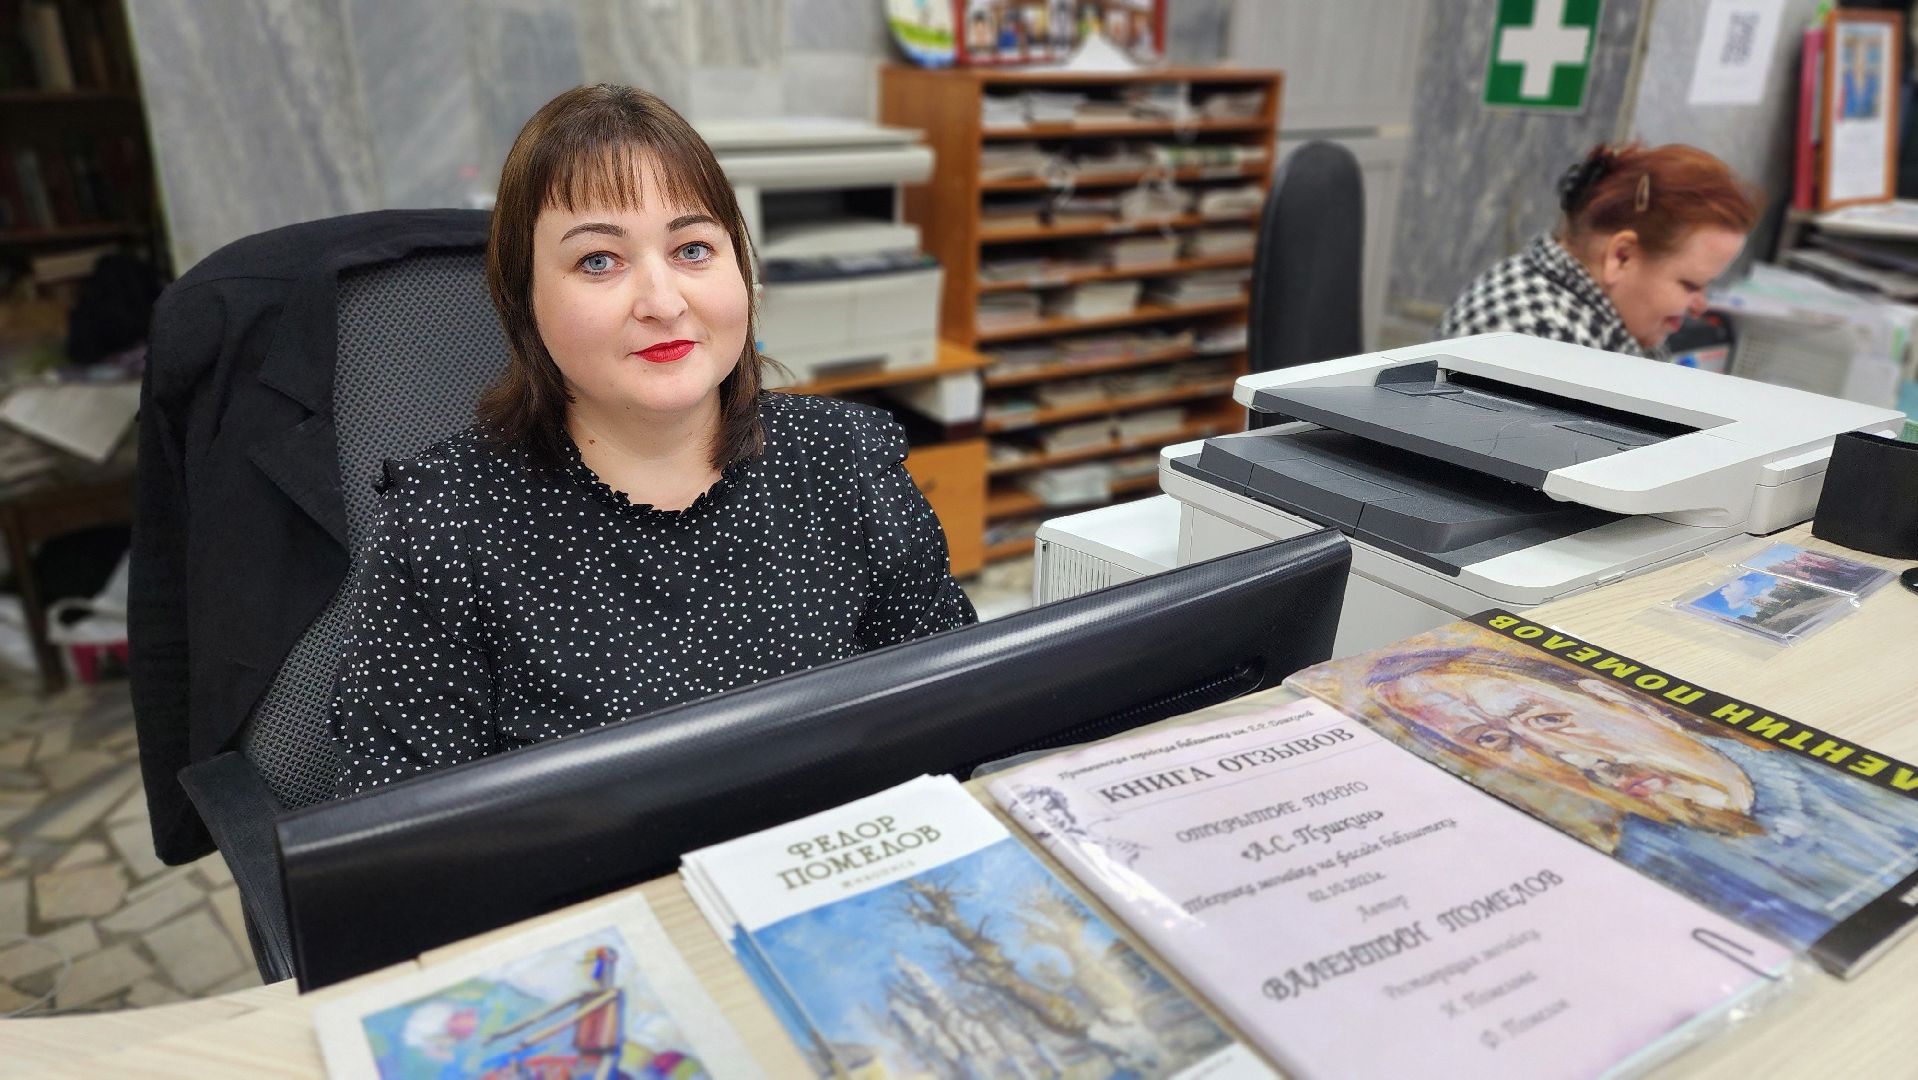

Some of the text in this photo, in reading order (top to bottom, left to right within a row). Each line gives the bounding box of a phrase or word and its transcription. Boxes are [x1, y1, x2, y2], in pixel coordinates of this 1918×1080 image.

[1488, 615, 1706, 705] ПОМЕЛОВ
[1100, 727, 1355, 805] КНИГА ОТЗЫВОВ
[787, 815, 897, 859] ФЕДОР
[1175, 781, 1369, 843] ОТКРЫТИЕ ПАННО
[776, 825, 941, 891] ПОМЕЛОВ
[1261, 920, 1433, 1001] ВАЛЕНТИН
[1436, 868, 1564, 932] ПОМЕЛОВ
